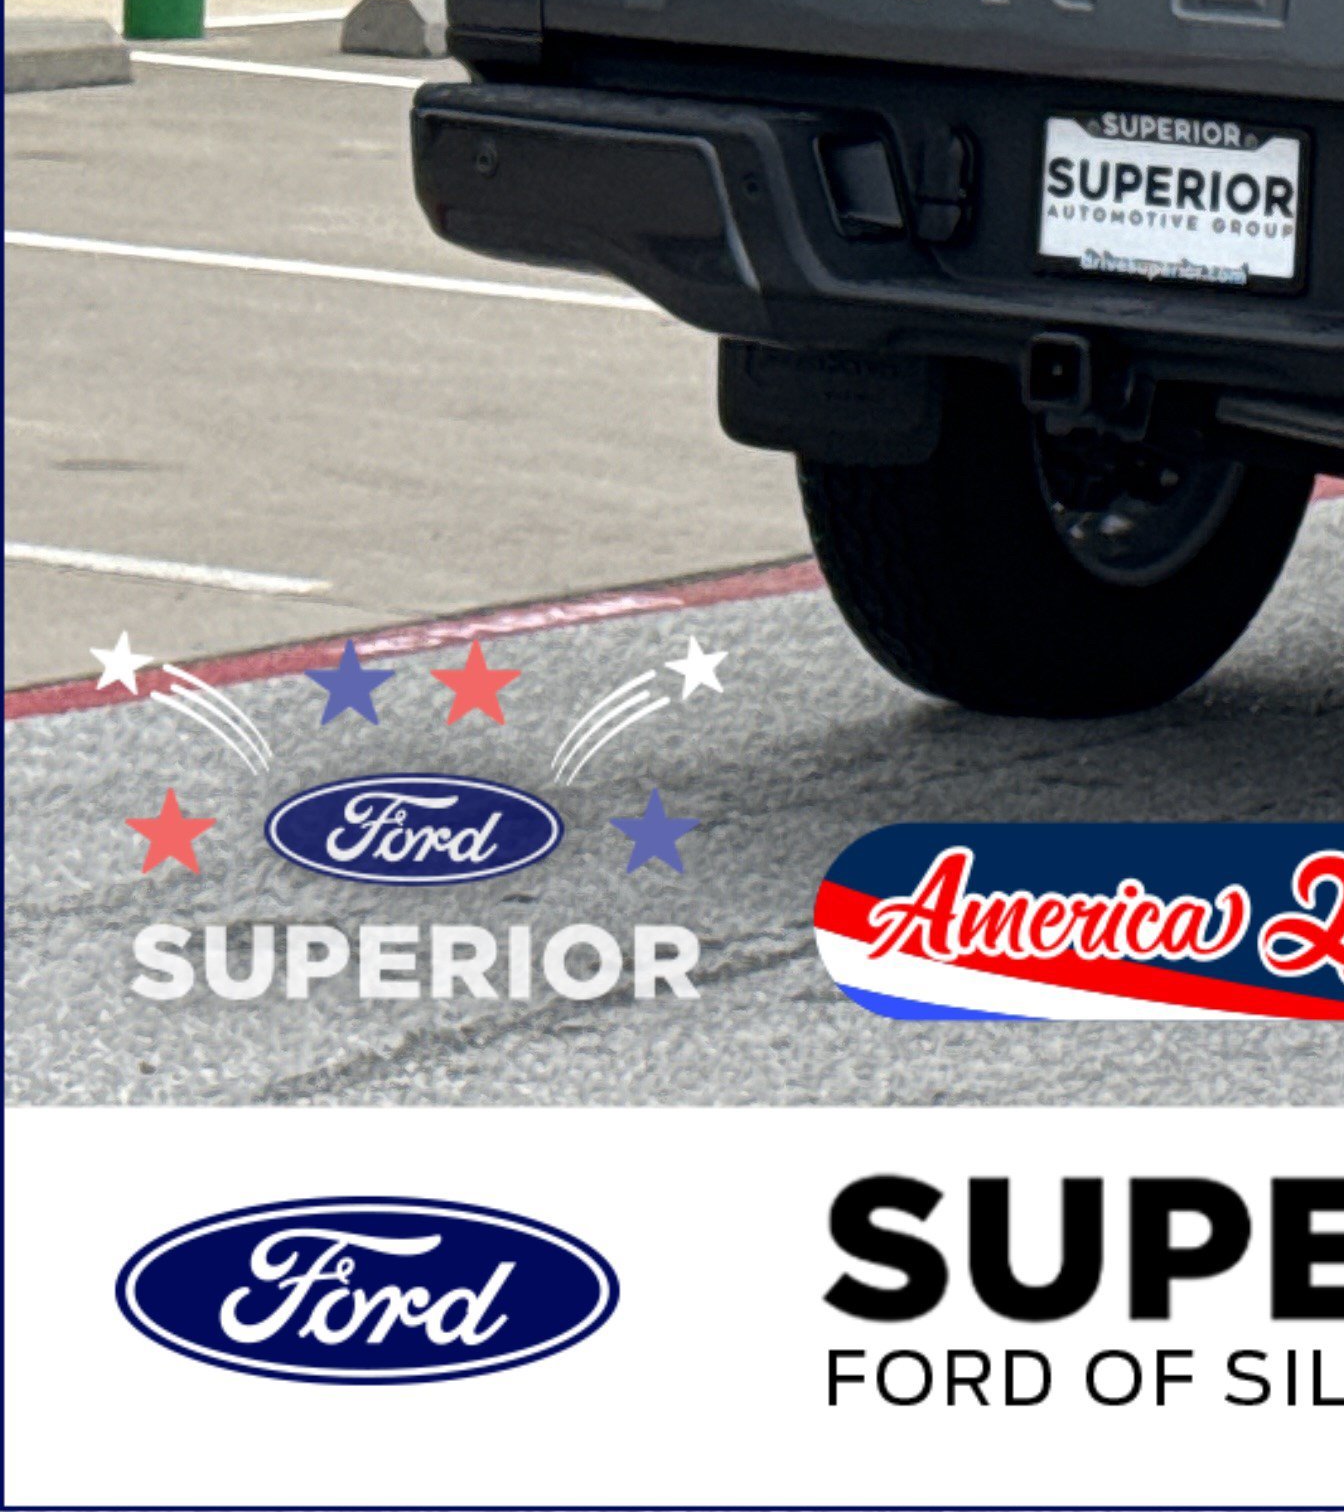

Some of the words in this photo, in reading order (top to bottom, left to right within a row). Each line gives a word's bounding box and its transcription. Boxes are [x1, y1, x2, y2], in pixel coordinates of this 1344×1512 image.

[1101, 111, 1242, 148] SUPERIOR
[1047, 156, 1294, 219] SUPERIOR
[1047, 203, 1199, 232] AUTOMOTIVE
[1211, 217, 1294, 240] GROUP
